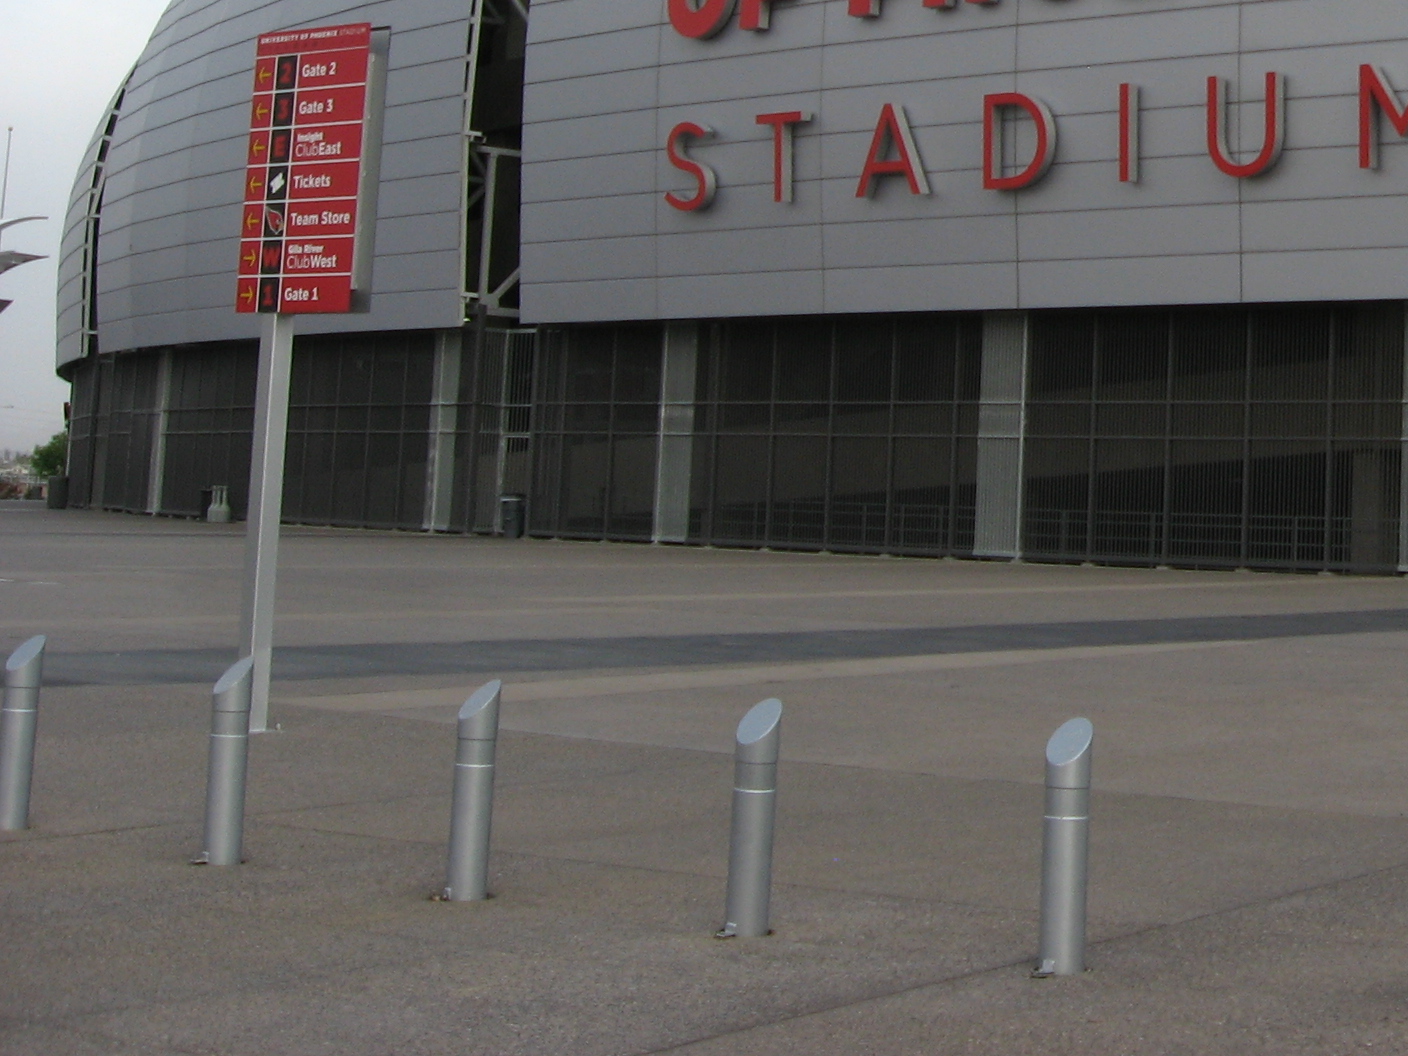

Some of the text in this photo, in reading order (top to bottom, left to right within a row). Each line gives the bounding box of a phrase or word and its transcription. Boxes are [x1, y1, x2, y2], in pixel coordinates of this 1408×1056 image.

[281, 62, 292, 83] 2
[302, 62, 337, 77] Gate 2
[278, 99, 288, 119] 3
[299, 99, 334, 114] Gate 3
[297, 132, 323, 142] Insight
[274, 135, 286, 157] E
[293, 175, 331, 188] Tickets
[290, 211, 350, 225] Team Store
[263, 248, 280, 267] W
[263, 285, 273, 306] 1
[284, 287, 318, 301] Gate 1
